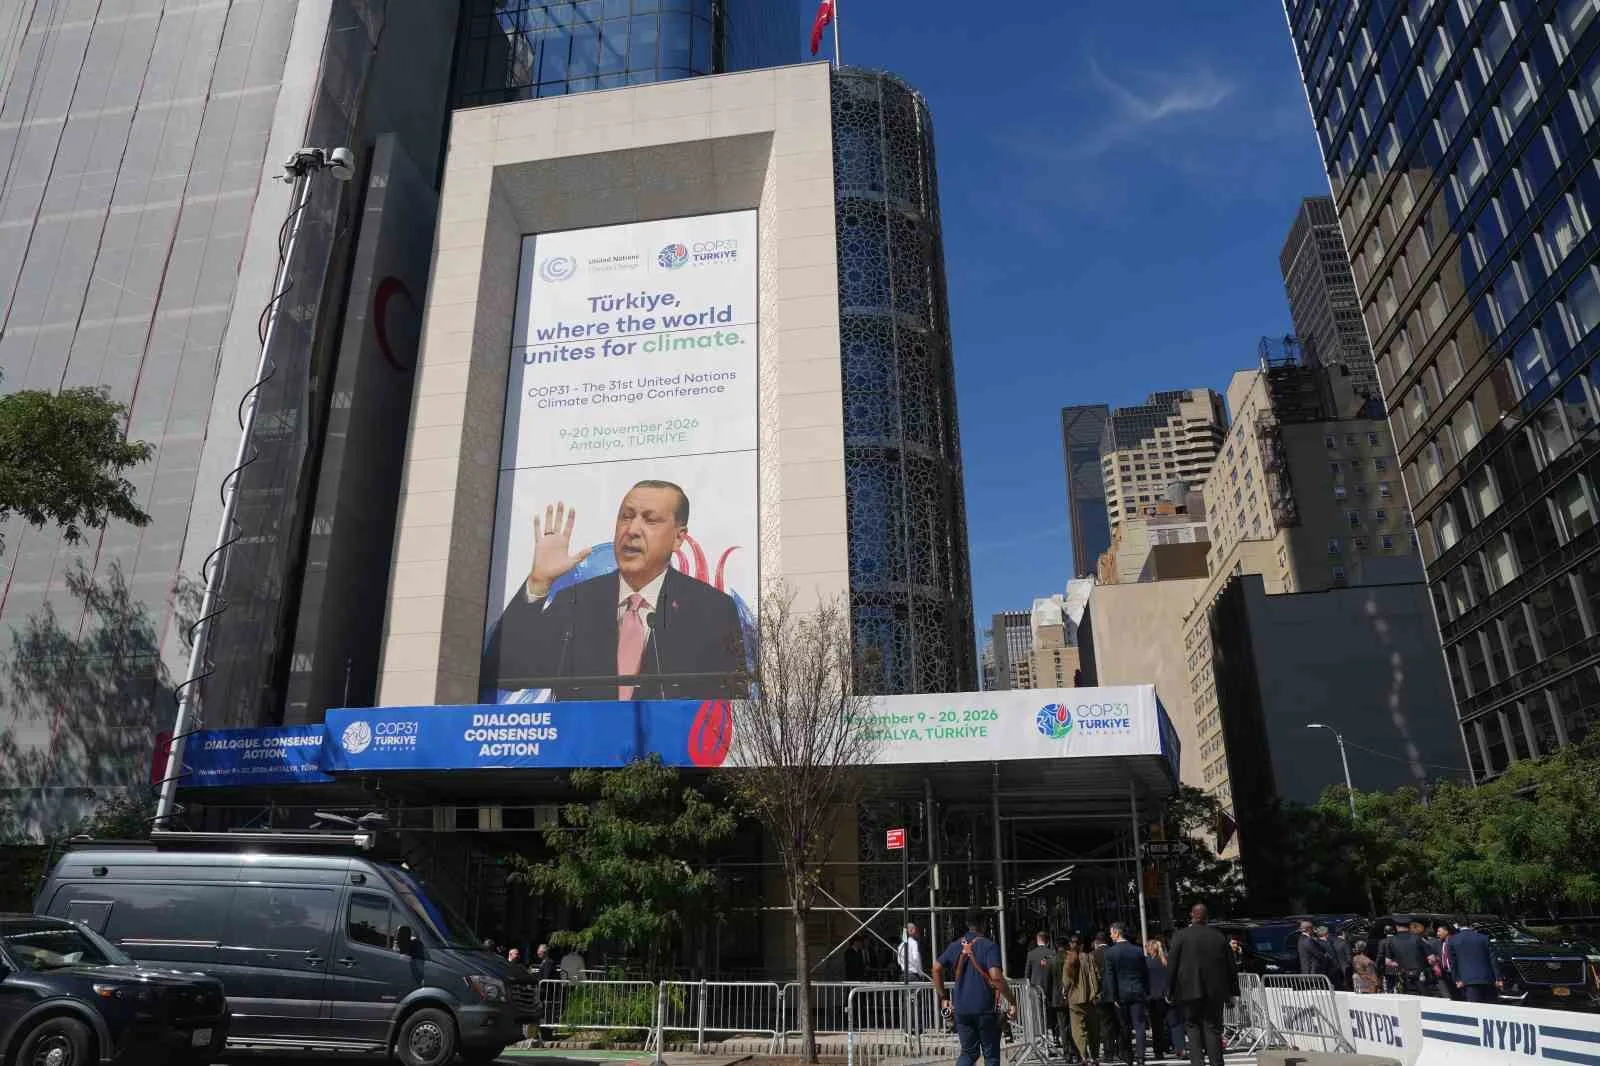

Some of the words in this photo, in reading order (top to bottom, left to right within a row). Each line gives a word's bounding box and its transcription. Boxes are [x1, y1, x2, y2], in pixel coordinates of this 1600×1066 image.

[588, 291, 681, 314] Türkiye,
[536, 322, 609, 341] where
[616, 314, 656, 334] the
[662, 304, 732, 328] world
[523, 342, 595, 366] unites
[602, 340, 637, 359] for
[643, 330, 745, 353] climate.
[528, 385, 570, 398] COP31
[583, 382, 606, 392] The
[609, 379, 633, 390] 31st
[637, 375, 681, 387] United
[684, 370, 737, 383] Nations
[538, 397, 588, 409] Climate
[591, 392, 643, 404] Change
[647, 385, 725, 399] Conference
[559, 426, 590, 438] 9-20
[593, 421, 662, 436] November
[665, 418, 699, 429] 2026
[570, 437, 624, 451] Antalya,
[917, 712, 926, 722] 9
[938, 711, 960, 723] 20,
[963, 709, 998, 721] 2026
[1077, 704, 1129, 717] COP31
[376, 722, 418, 735] COP31
[473, 713, 551, 727] DIALOGUE
[263, 735, 323, 747] CONSENSU
[464, 728, 558, 742] CONSENSUS
[479, 743, 540, 757] ACTION
[1355, 1009, 1394, 1046] NYPD
[1483, 1018, 1537, 1056] NYPD
